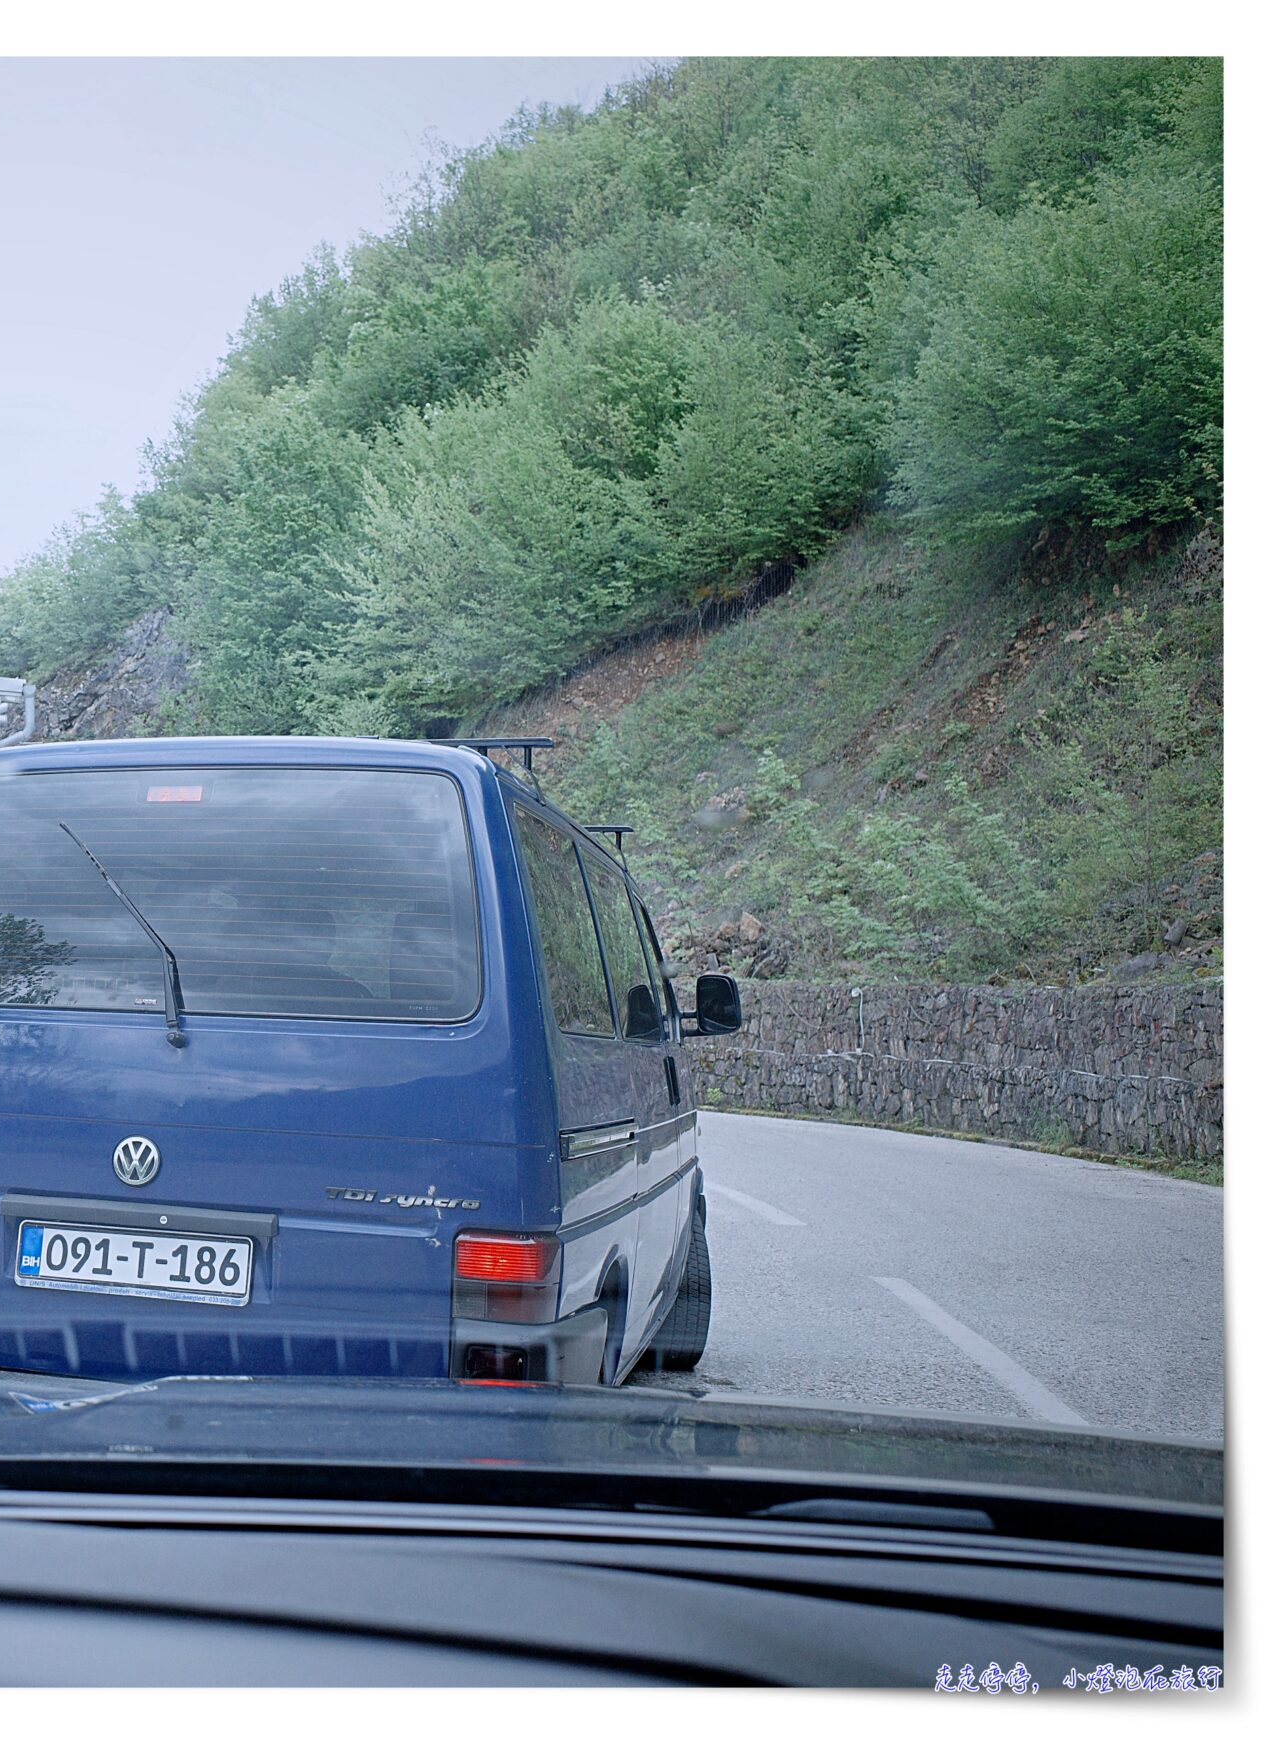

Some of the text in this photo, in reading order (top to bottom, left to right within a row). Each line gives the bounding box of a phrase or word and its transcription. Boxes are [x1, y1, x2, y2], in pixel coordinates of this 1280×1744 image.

[113, 1136, 161, 1186] VW
[325, 1186, 481, 1211] TDI syncro
[22, 1256, 40, 1267] BIH
[45, 1233, 241, 1287] 091-T-186
